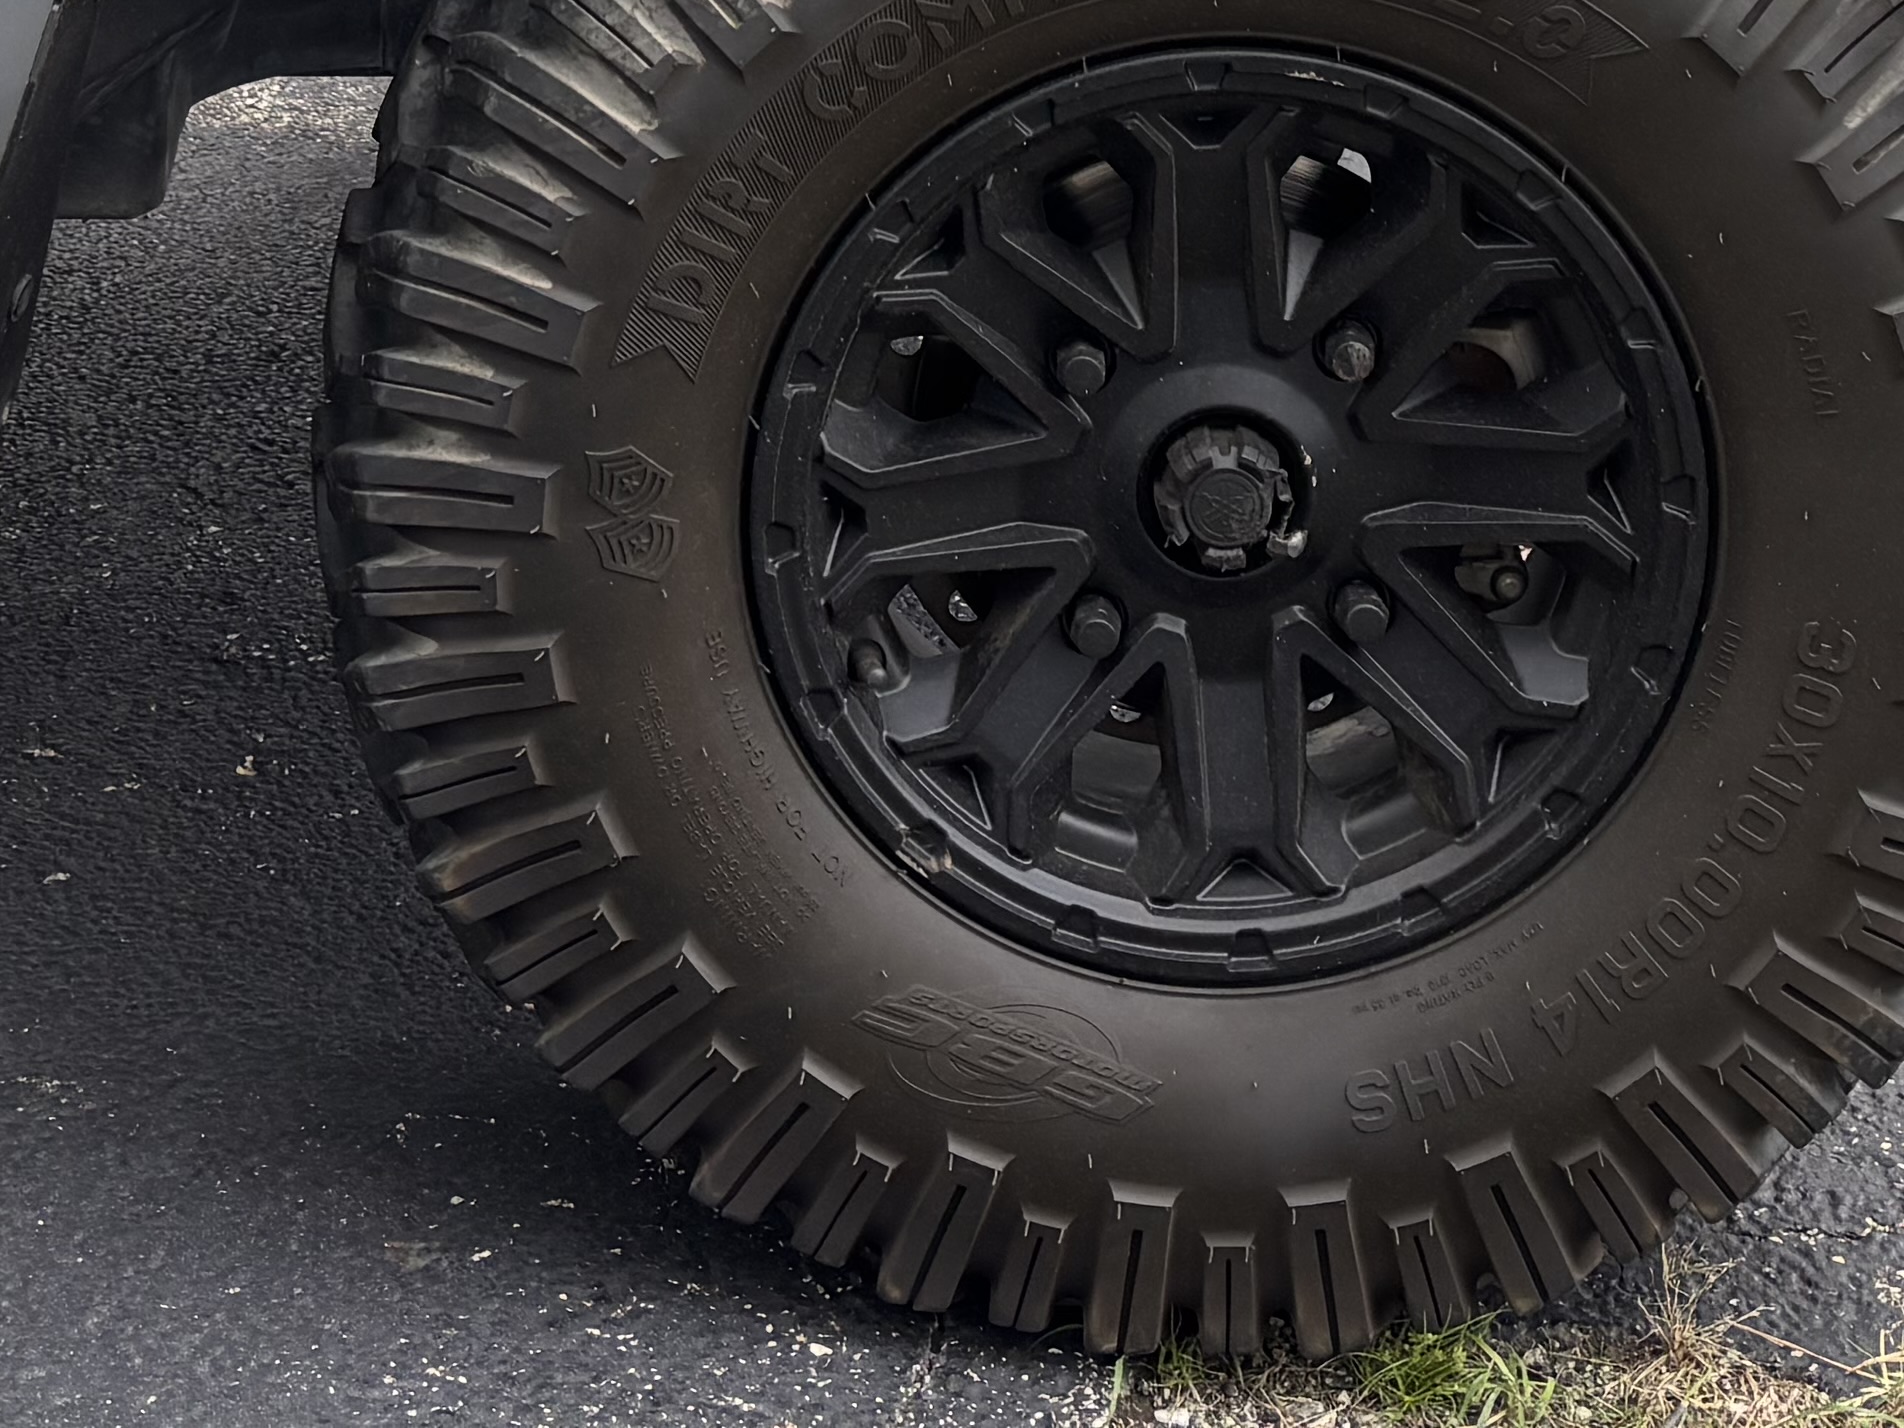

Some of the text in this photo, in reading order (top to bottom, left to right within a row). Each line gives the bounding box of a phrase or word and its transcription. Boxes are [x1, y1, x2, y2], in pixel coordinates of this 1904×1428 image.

[646, 130, 796, 326] DIRT
[775, 795, 814, 840] FOR
[811, 843, 853, 887] NOT
[908, 993, 1154, 1092] MOTORSPORTS
[1344, 1027, 1515, 1134] NHS
